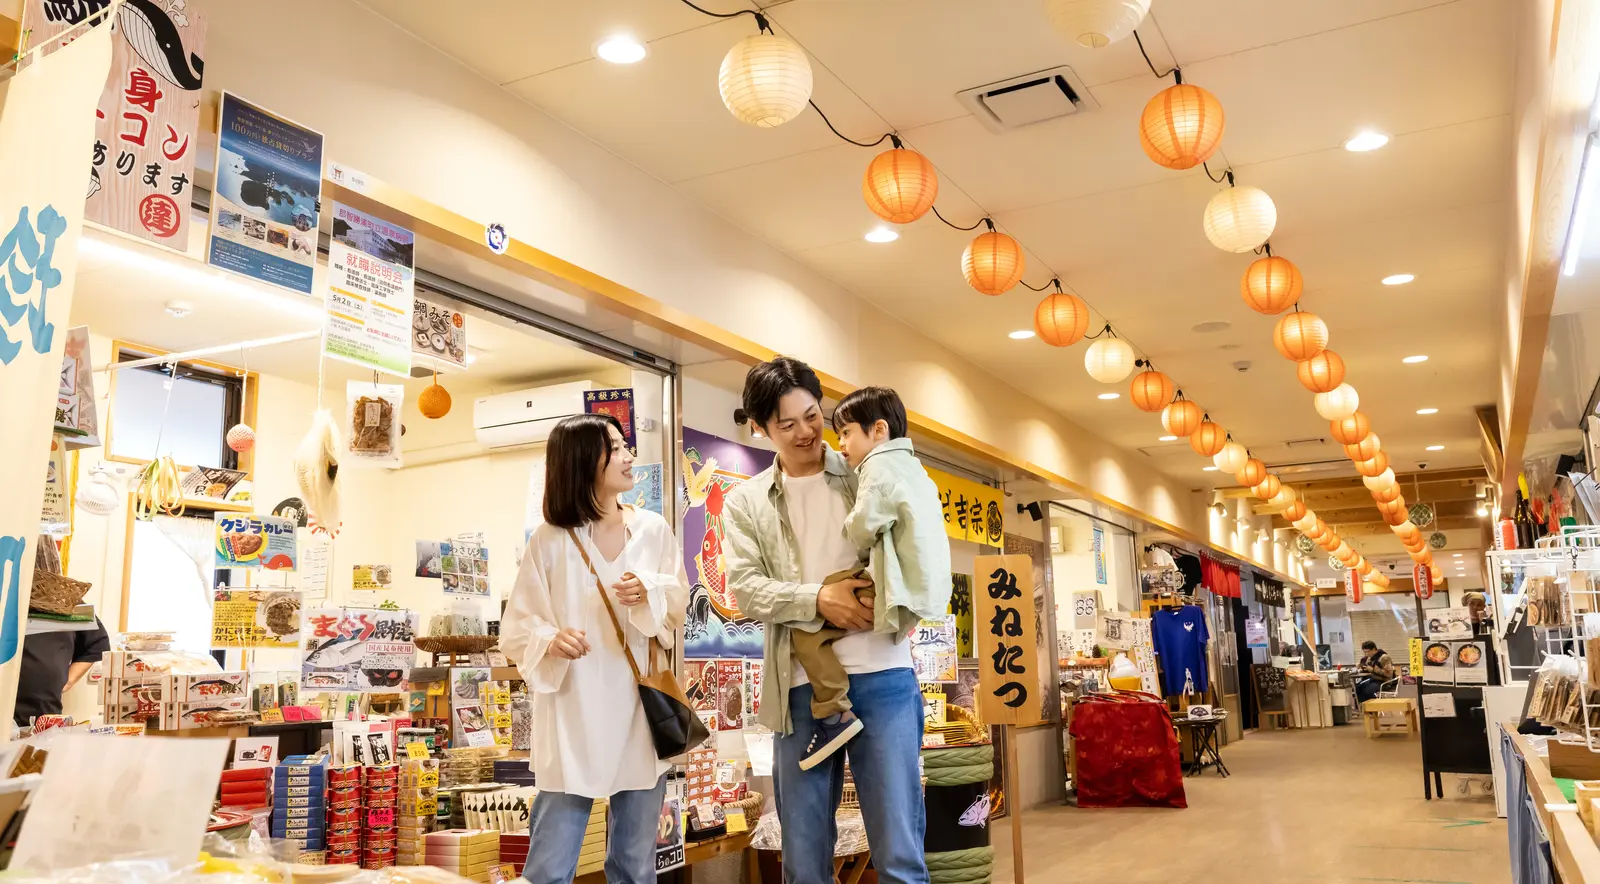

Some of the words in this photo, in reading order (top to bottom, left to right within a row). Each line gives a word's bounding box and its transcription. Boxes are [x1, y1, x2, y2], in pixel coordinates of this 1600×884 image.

[346, 252, 403, 285] 就職説明会
[413, 299, 451, 325] 鯛みそ
[587, 390, 632, 402] 高級珍味
[220, 518, 294, 535] クジラカレー
[919, 628, 947, 641] カレー
[987, 567, 1028, 707] みねたつ
[368, 644, 412, 653] 国産昆布使用
